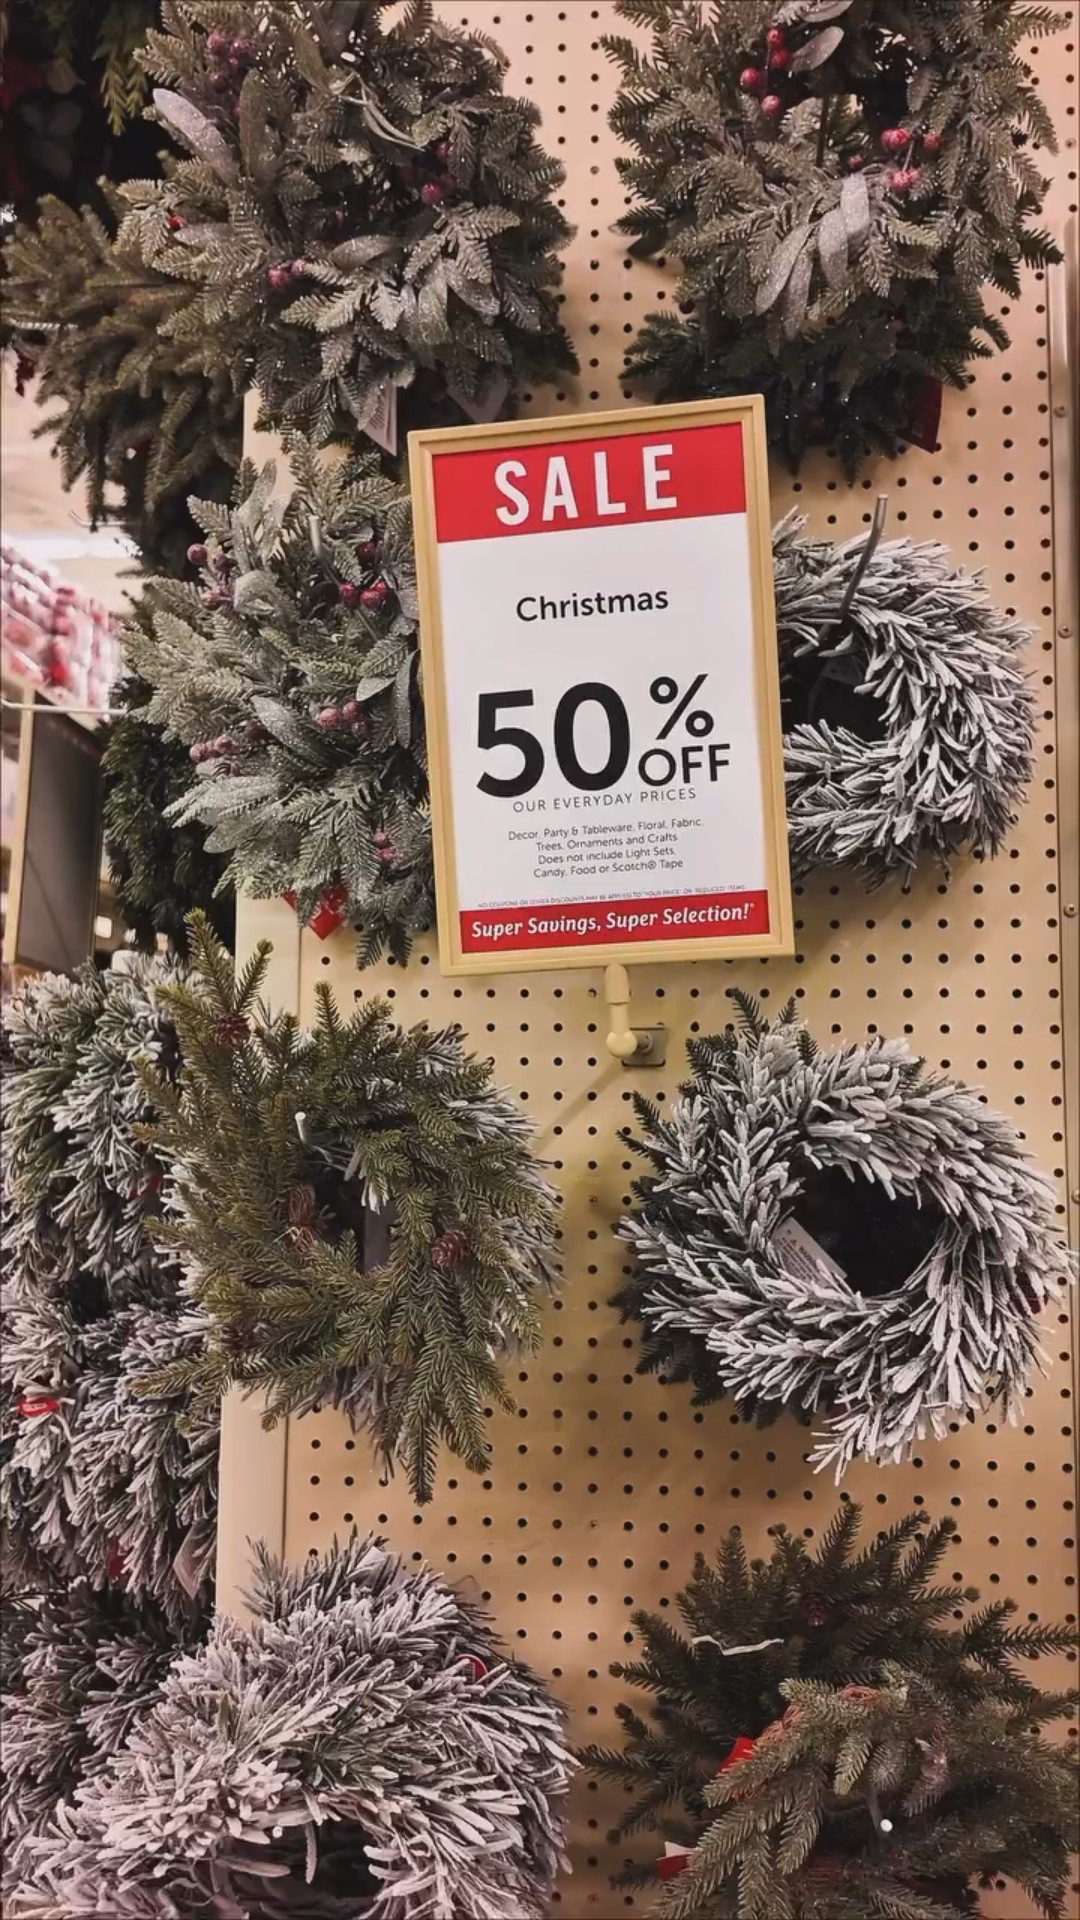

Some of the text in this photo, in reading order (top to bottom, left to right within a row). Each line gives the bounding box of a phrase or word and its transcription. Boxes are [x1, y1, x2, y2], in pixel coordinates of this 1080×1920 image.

[494, 443, 677, 526] SALE
[516, 590, 668, 621] Christmas
[638, 743, 731, 786] OFF
[512, 787, 696, 813] OUR EVERYDAY PRICES
[508, 830, 540, 841] Decor,
[544, 827, 569, 839] Party
[571, 826, 579, 836] &
[567, 836, 624, 850] Ornaments
[626, 835, 645, 845] and
[647, 833, 678, 844] Crafts
[538, 854, 564, 865] Does
[566, 854, 584, 862] not
[586, 850, 623, 860] include
[626, 847, 651, 860] Light
[570, 865, 597, 876] Food
[598, 865, 610, 874] or
[659, 859, 684, 871] Tape
[471, 921, 524, 941] Super
[527, 915, 601, 935] Savings,
[606, 912, 659, 933] Super
